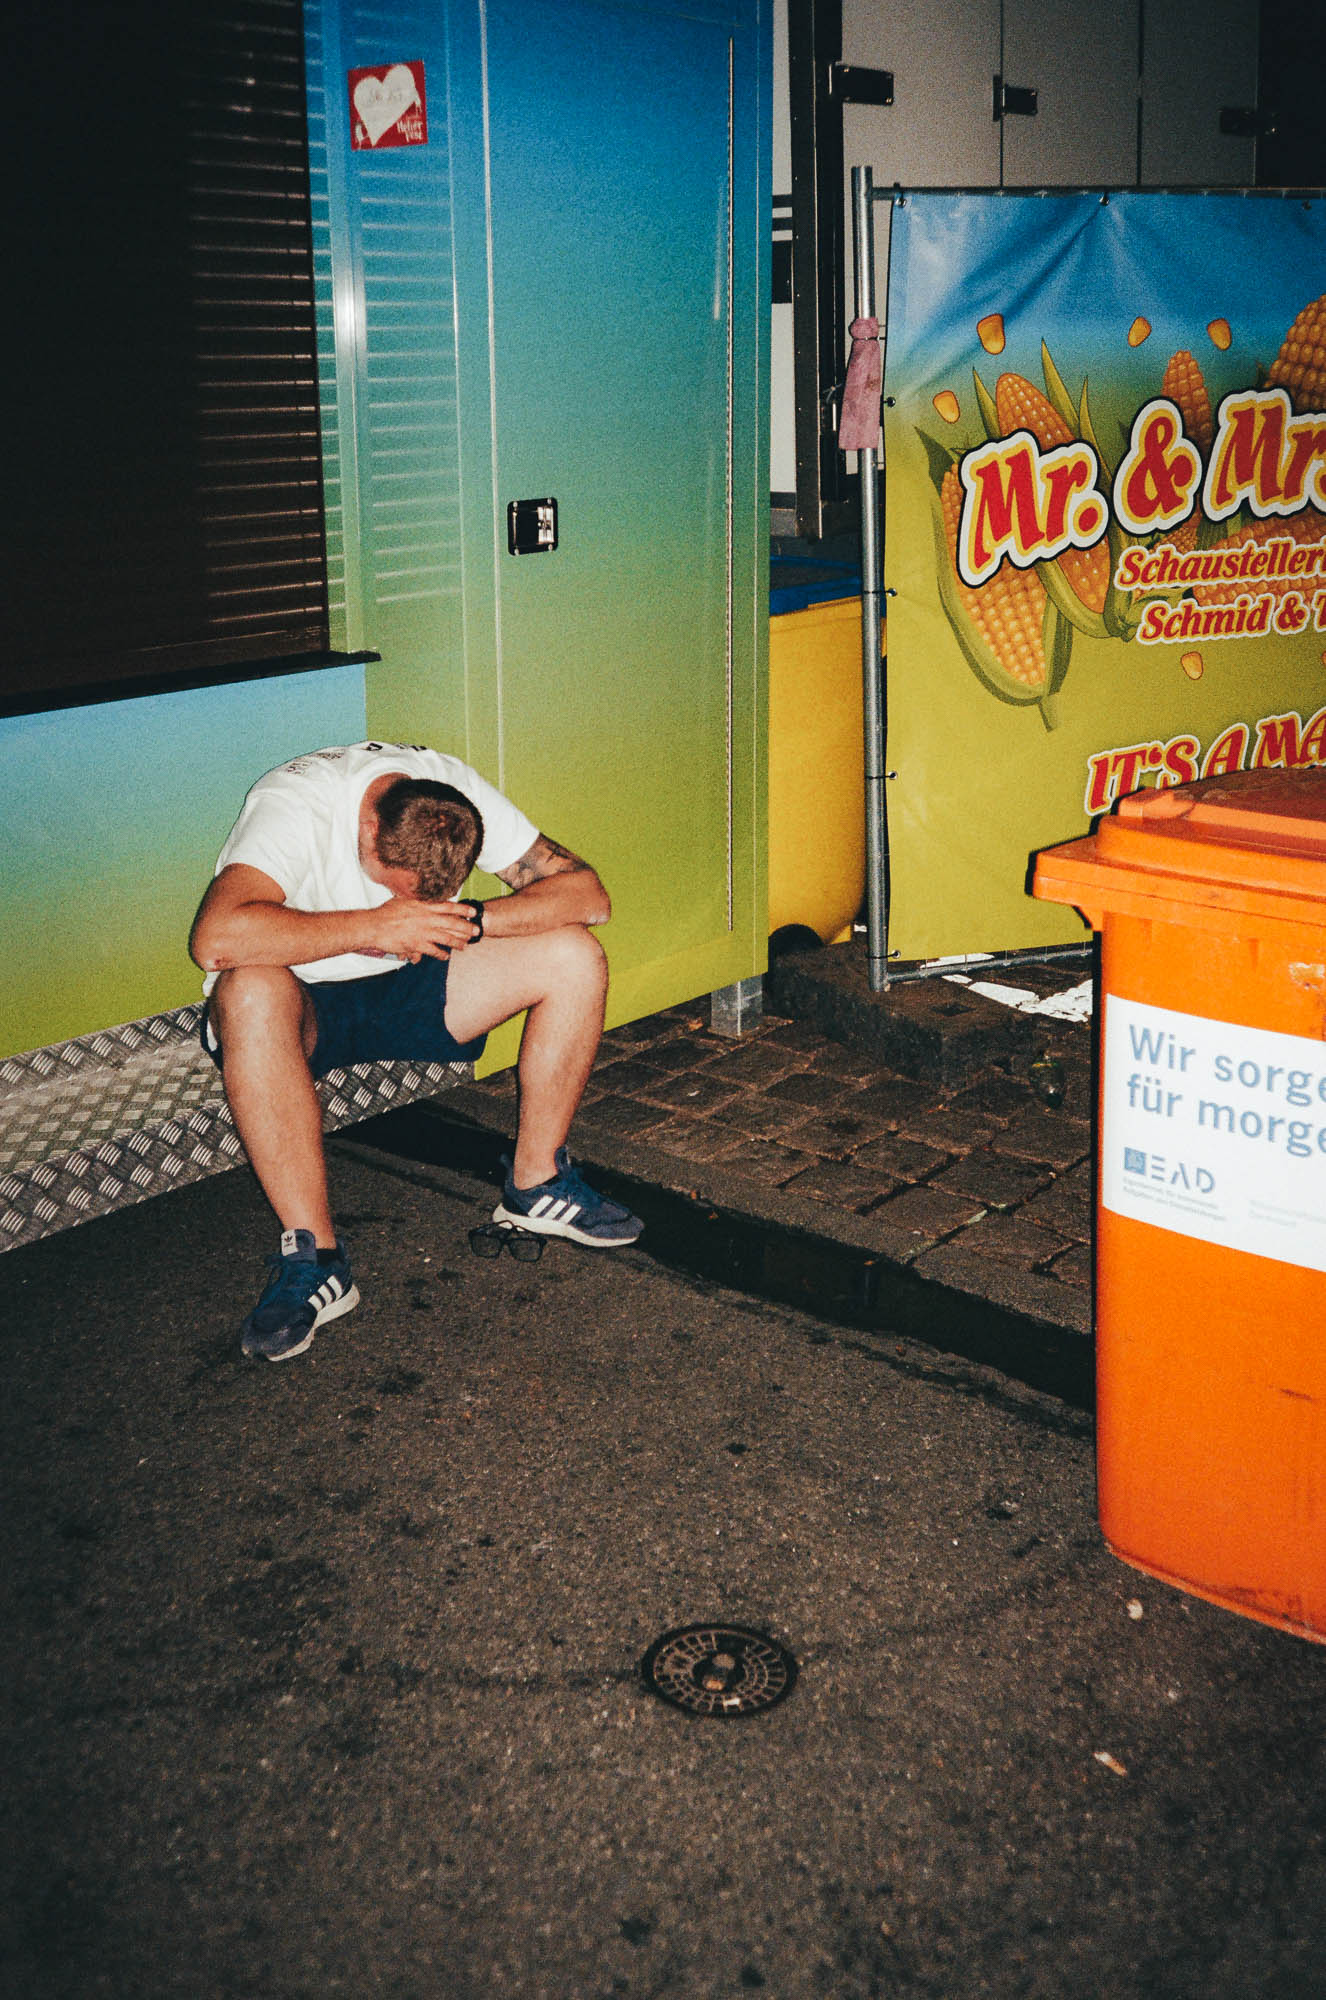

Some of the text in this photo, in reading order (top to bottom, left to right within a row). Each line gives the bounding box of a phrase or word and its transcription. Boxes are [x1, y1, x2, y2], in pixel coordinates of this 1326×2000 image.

[964, 396, 1326, 578] Mr. & Mr
[1139, 596, 1274, 642] Schmid
[1275, 593, 1309, 632] &
[1203, 725, 1247, 780] A
[1128, 1023, 1196, 1072] Wir
[1127, 1073, 1183, 1117] für
[1151, 1154, 1216, 1193] EAD
